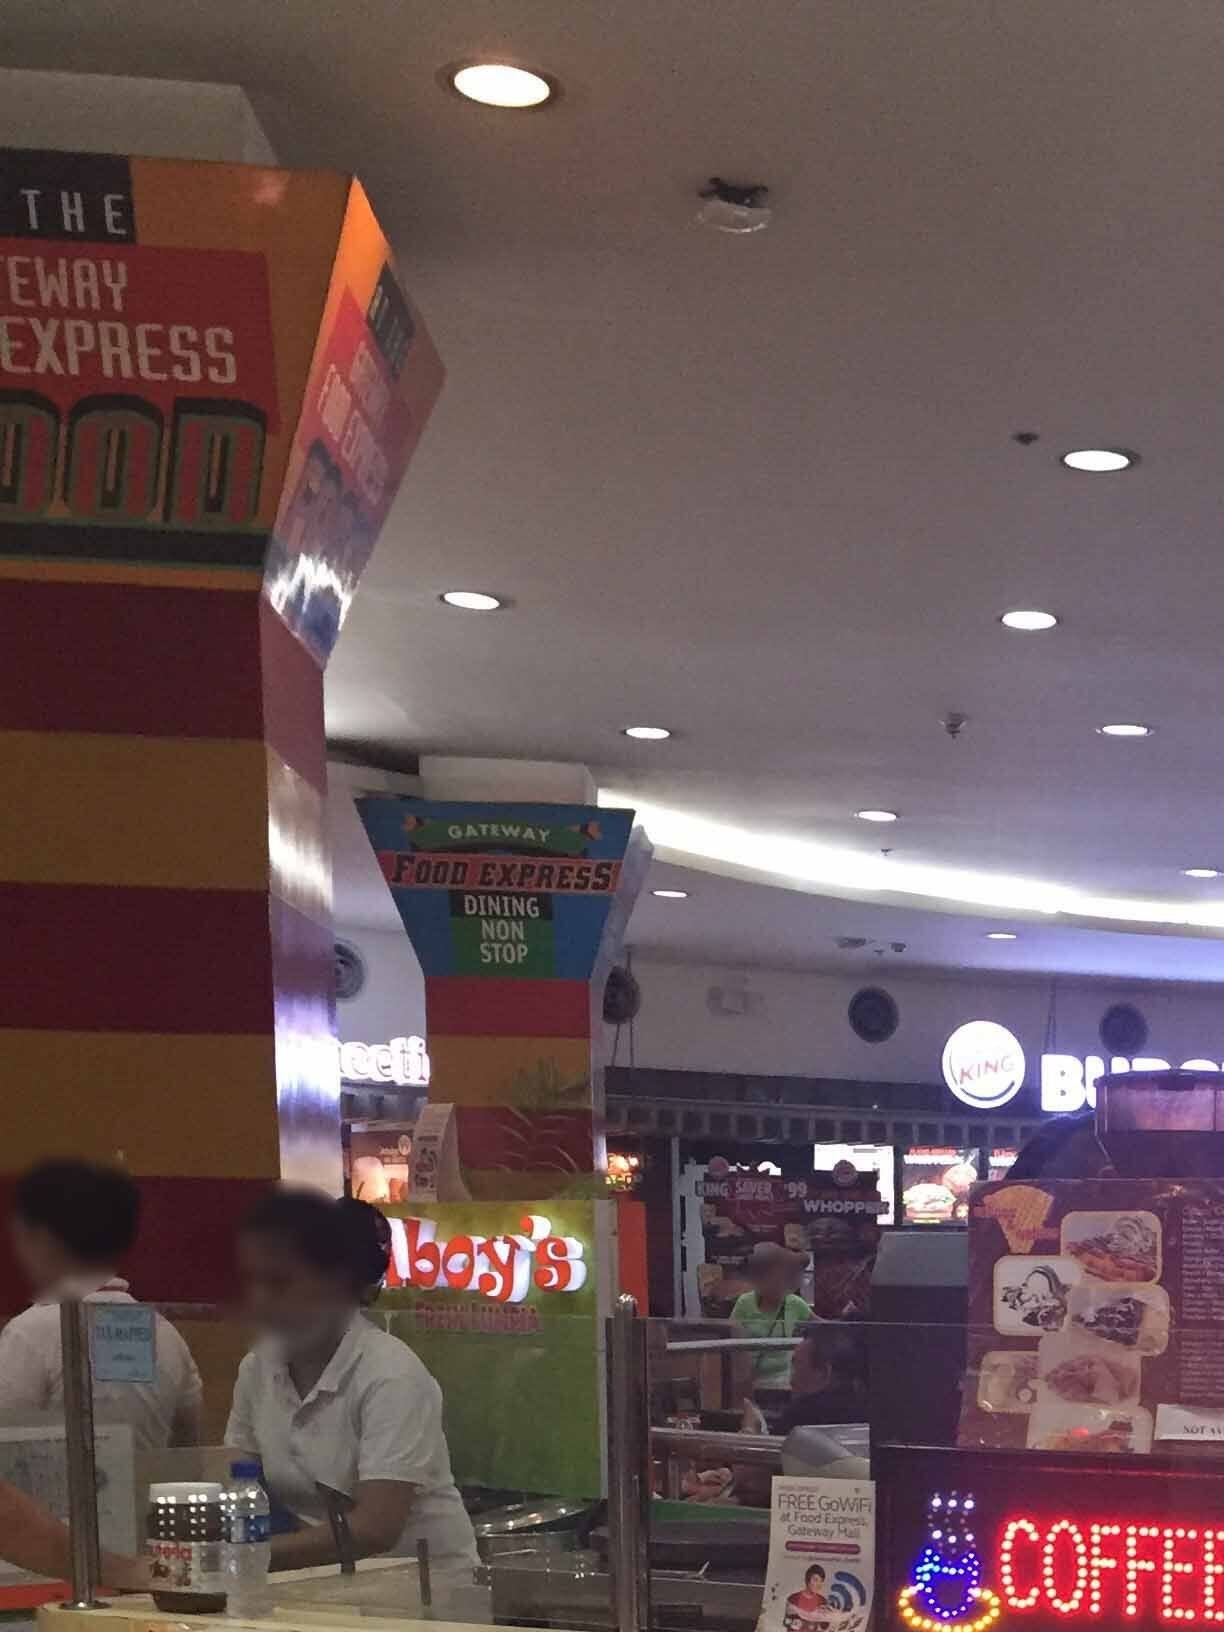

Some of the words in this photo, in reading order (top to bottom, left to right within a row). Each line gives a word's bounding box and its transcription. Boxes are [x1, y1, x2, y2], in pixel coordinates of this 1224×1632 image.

[20, 188, 128, 235] THE
[0, 254, 129, 312] EWAY
[0, 316, 238, 385] EXPRESS
[448, 823, 551, 843] GATEWAY
[479, 861, 613, 891] EXPRESS
[463, 894, 540, 918] DINING
[480, 919, 524, 942] NON
[479, 943, 529, 964] STOP
[957, 1057, 1017, 1085] KING
[777, 1493, 816, 1511] FREE
[794, 1512, 822, 1524] Food
